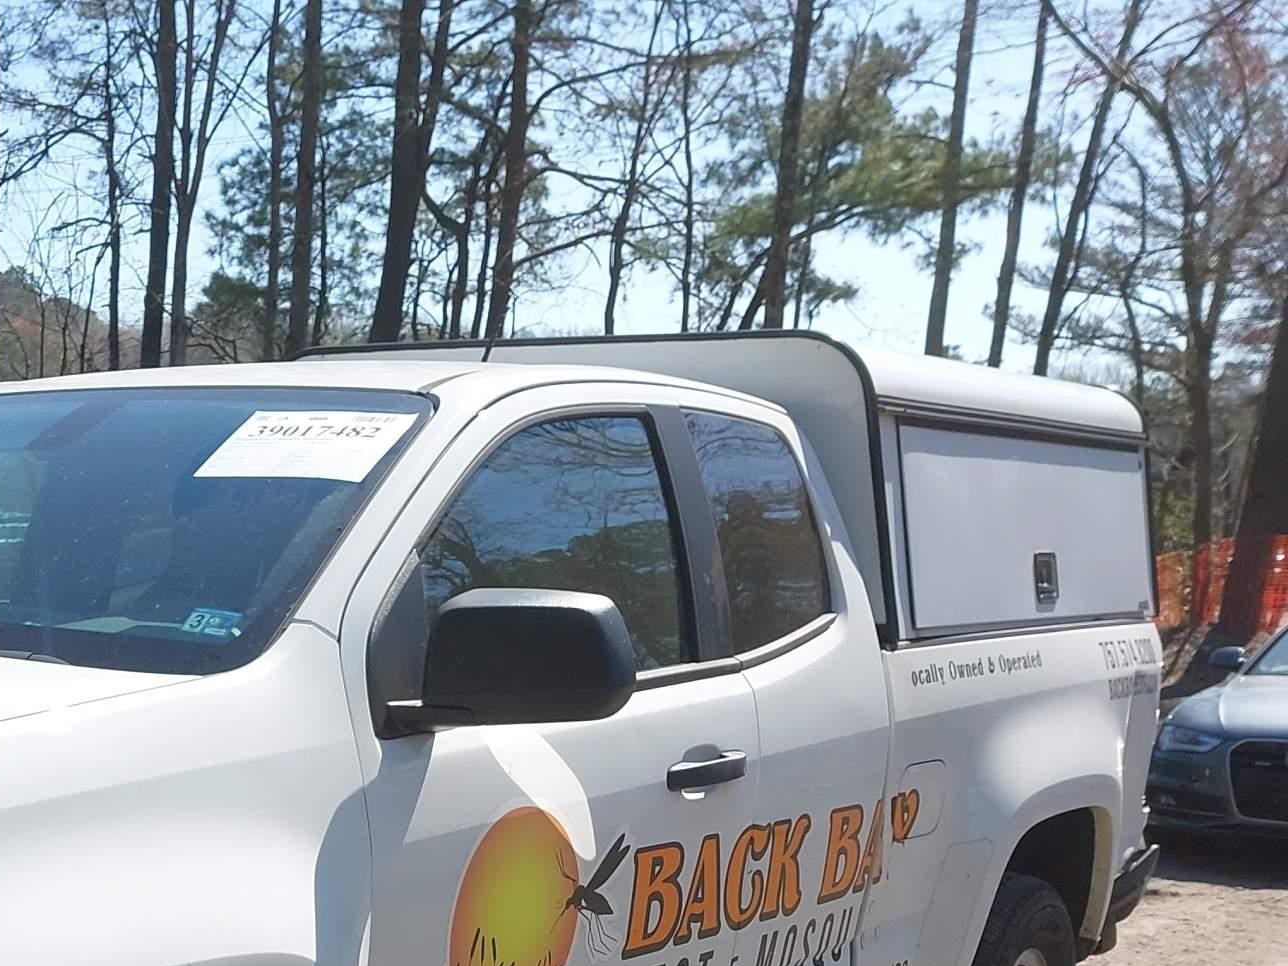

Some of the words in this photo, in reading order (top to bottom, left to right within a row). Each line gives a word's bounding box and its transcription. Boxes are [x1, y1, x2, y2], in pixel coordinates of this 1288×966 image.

[247, 425, 382, 438] 39017482
[948, 658, 985, 681] Owned
[998, 650, 1043, 675] Operated
[621, 813, 812, 961] BACK
